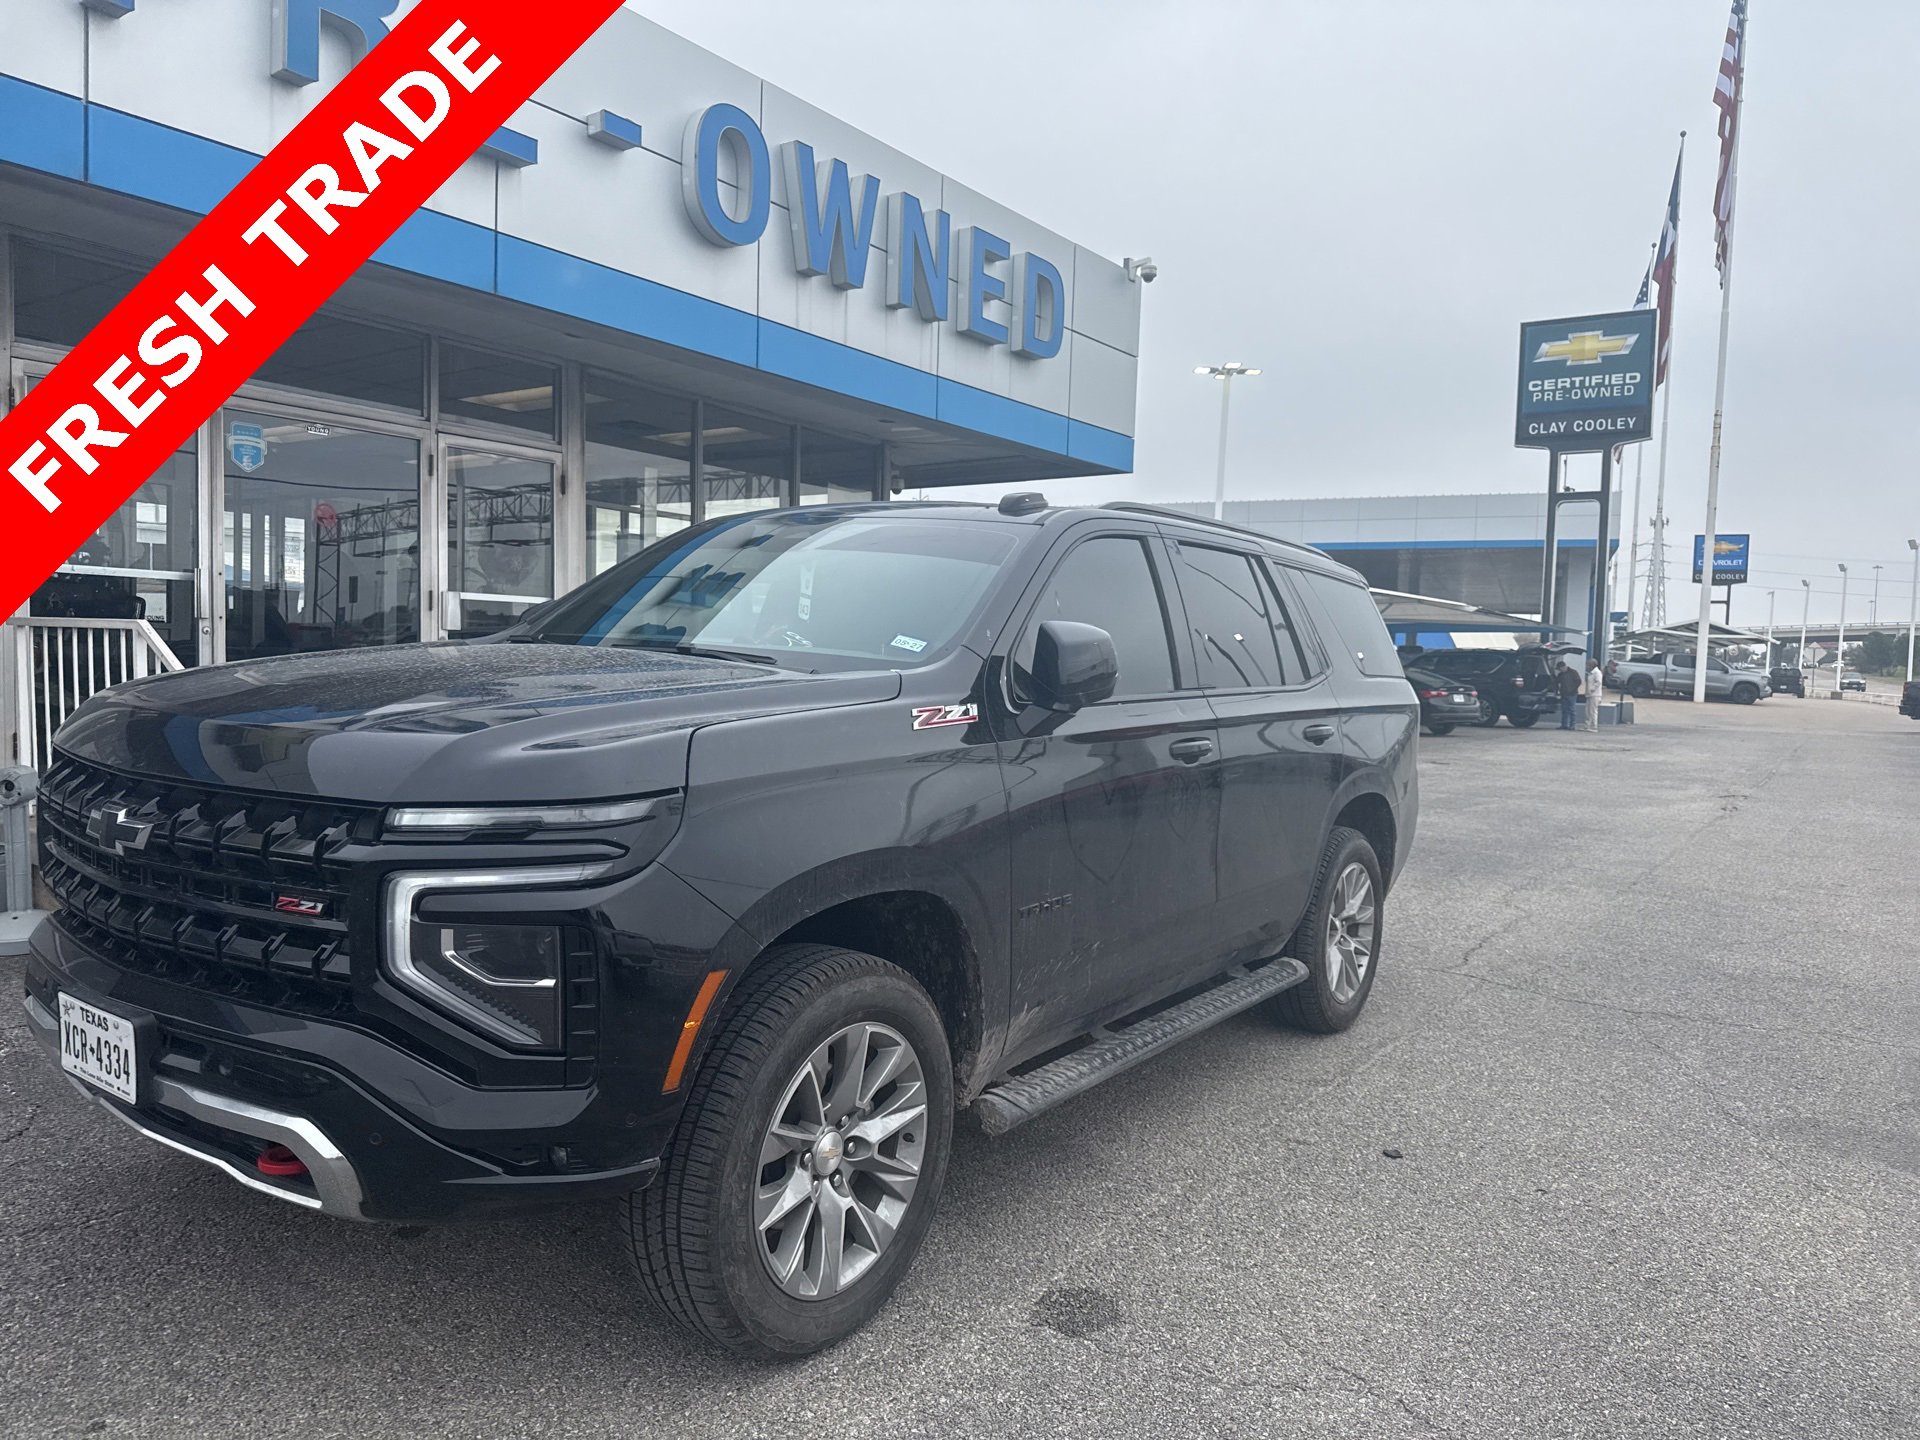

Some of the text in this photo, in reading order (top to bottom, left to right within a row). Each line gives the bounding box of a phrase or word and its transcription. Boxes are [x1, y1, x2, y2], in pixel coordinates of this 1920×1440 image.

[1528, 372, 1641, 391] CERTIFIED
[1532, 385, 1635, 402] PRE-OWNED
[1528, 417, 1636, 435] CLAY COOLEY
[80, 1007, 109, 1032] TEXAS
